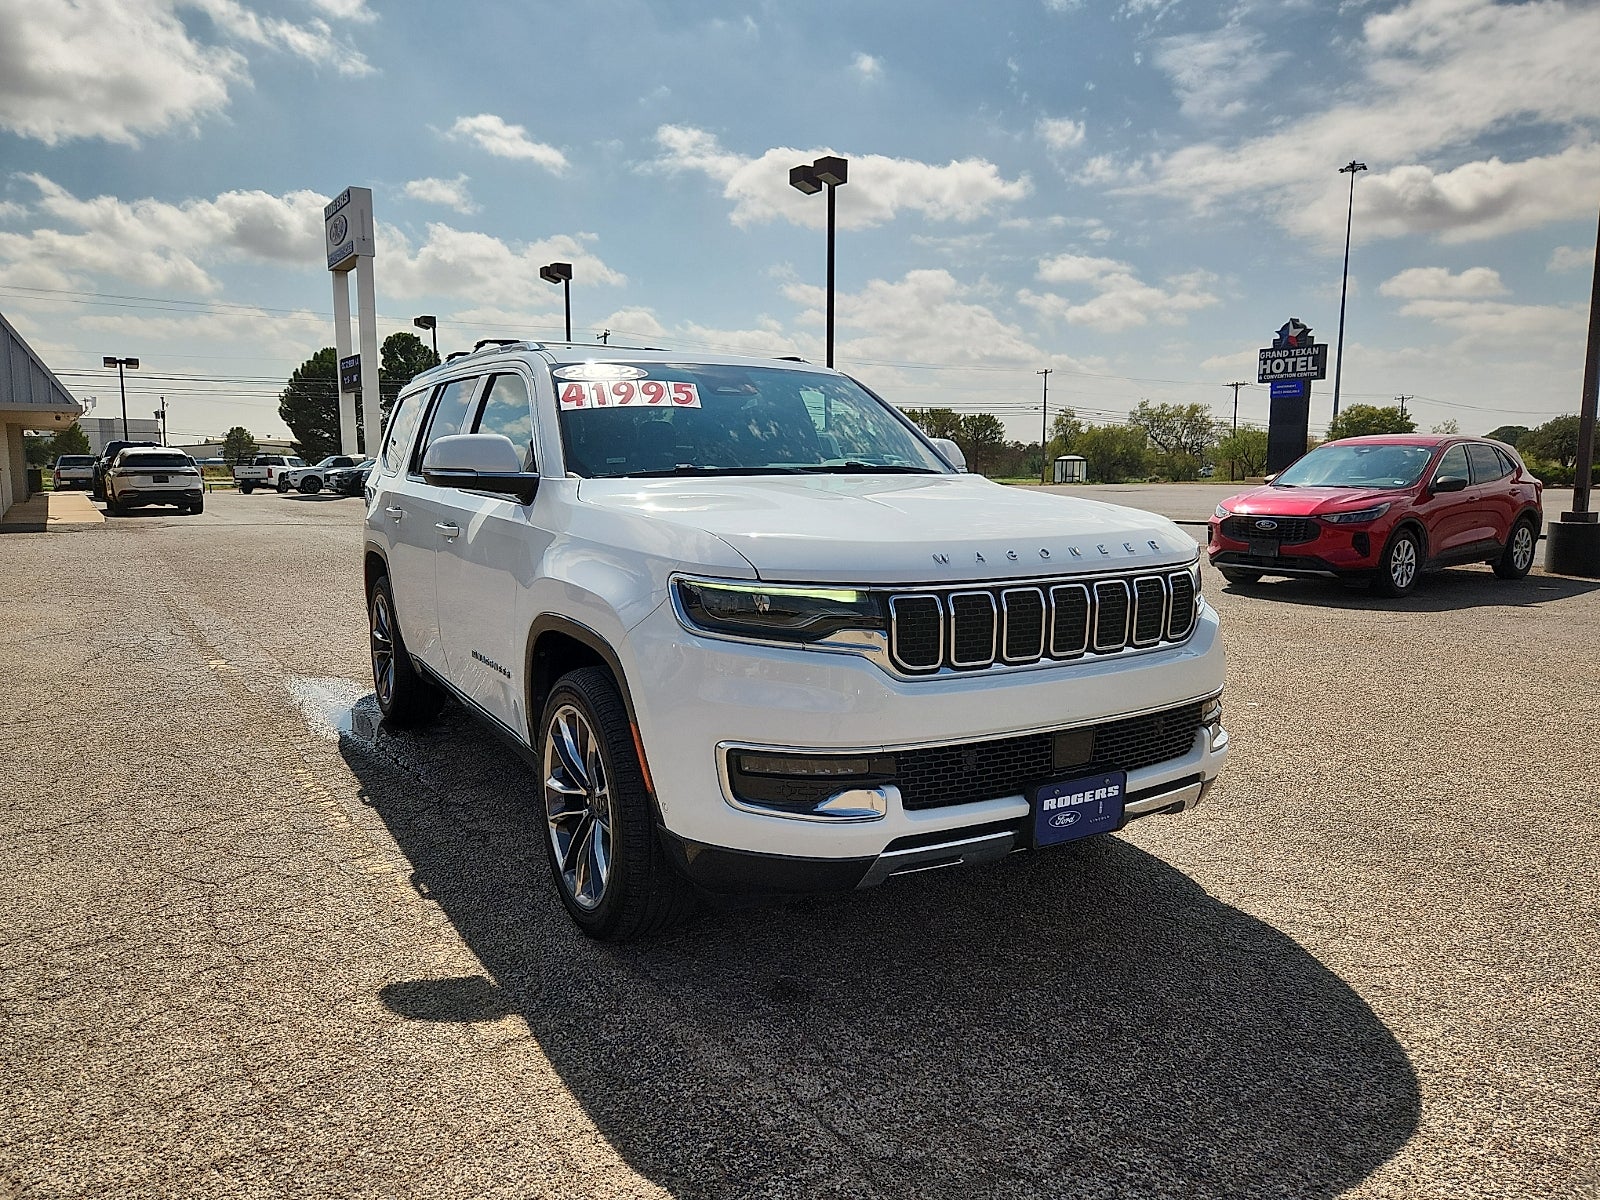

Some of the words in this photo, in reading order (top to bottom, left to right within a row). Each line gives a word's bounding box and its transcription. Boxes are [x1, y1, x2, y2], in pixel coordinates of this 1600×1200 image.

[1260, 350, 1289, 359] GRAND
[1291, 347, 1319, 356] TEXAN
[1259, 356, 1318, 374] HOTEL
[1263, 372, 1297, 380] CONVENTION
[561, 382, 696, 407] 41995
[932, 540, 1161, 565] WAGONEER
[1043, 784, 1120, 811] ROGERS
[1055, 813, 1076, 826] Ford
